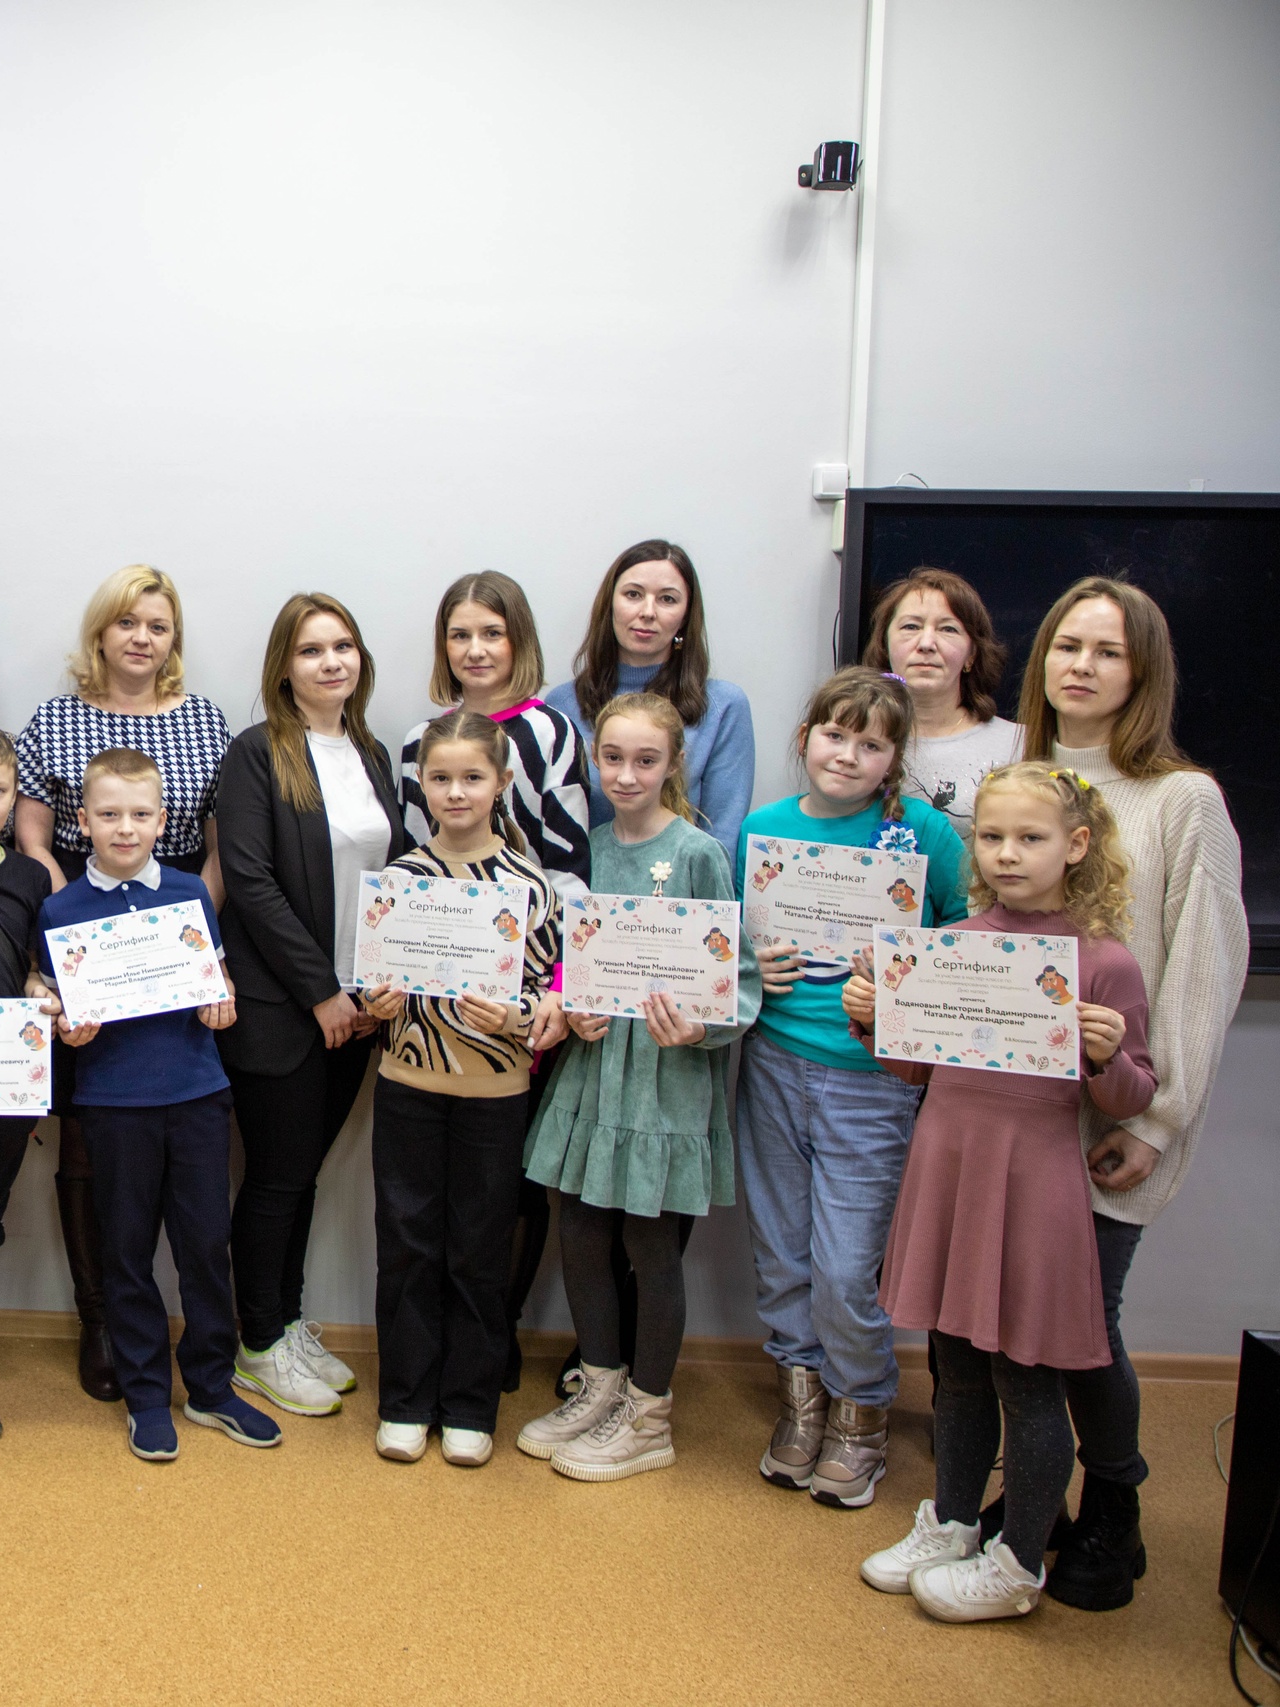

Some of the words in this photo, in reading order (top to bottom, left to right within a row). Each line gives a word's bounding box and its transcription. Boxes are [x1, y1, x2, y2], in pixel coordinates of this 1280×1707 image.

[797, 866, 867, 883] Сертификат
[408, 900, 473, 915] Сертификат
[774, 901, 806, 911] Шоиным
[807, 906, 831, 915] Софье
[832, 909, 879, 922] Николаевне
[784, 909, 814, 920] Наталье
[814, 914, 873, 928] Александровне
[615, 920, 682, 935] Сертификат
[99, 933, 159, 951] Сертификат
[383, 936, 421, 946] Сазановым
[422, 940, 448, 949] Ксении
[449, 943, 489, 953] Андреевне
[403, 945, 435, 955] Светлане
[436, 949, 473, 959] Сергеевне
[87, 974, 123, 984] Тарасовым
[141, 962, 185, 974] Николаевичу
[593, 958, 625, 967] Ургиным
[626, 961, 650, 969] Марии
[652, 963, 699, 974] Михайловне
[602, 967, 640, 976] Анастасии
[641, 970, 695, 981] Владимировне
[933, 957, 1011, 974] Сертификат
[128, 970, 176, 983] Владимировне
[895, 998, 941, 1009] Водяновым
[942, 1002, 983, 1014] Виктории
[985, 1006, 1049, 1020] Владимировне
[923, 1010, 956, 1019] Наталье
[958, 1013, 1025, 1026] Александровне
